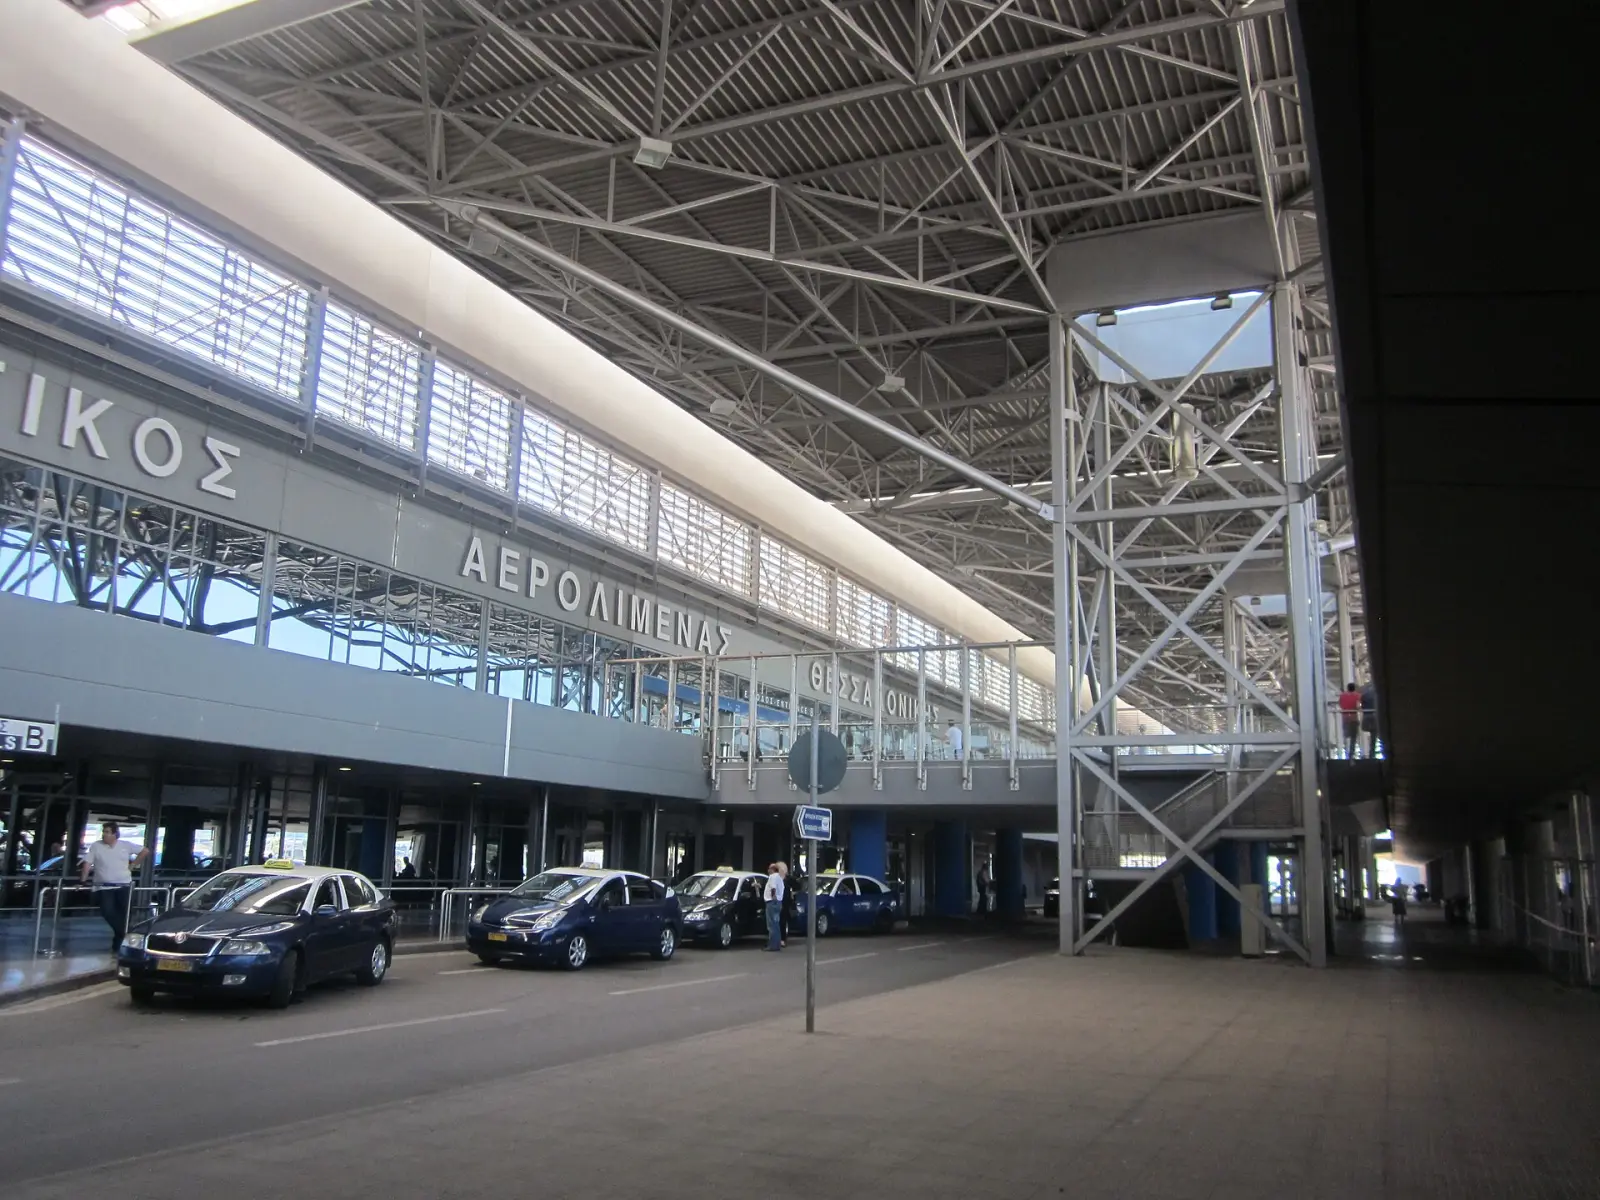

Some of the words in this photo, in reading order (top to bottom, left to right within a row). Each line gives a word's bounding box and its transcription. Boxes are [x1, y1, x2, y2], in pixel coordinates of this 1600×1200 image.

[0, 361, 241, 500] ΙΚΟΣ
[461, 535, 733, 656] ΑΕΡΟΛΙΜΕΝΑΣ
[26, 725, 44, 750] B
